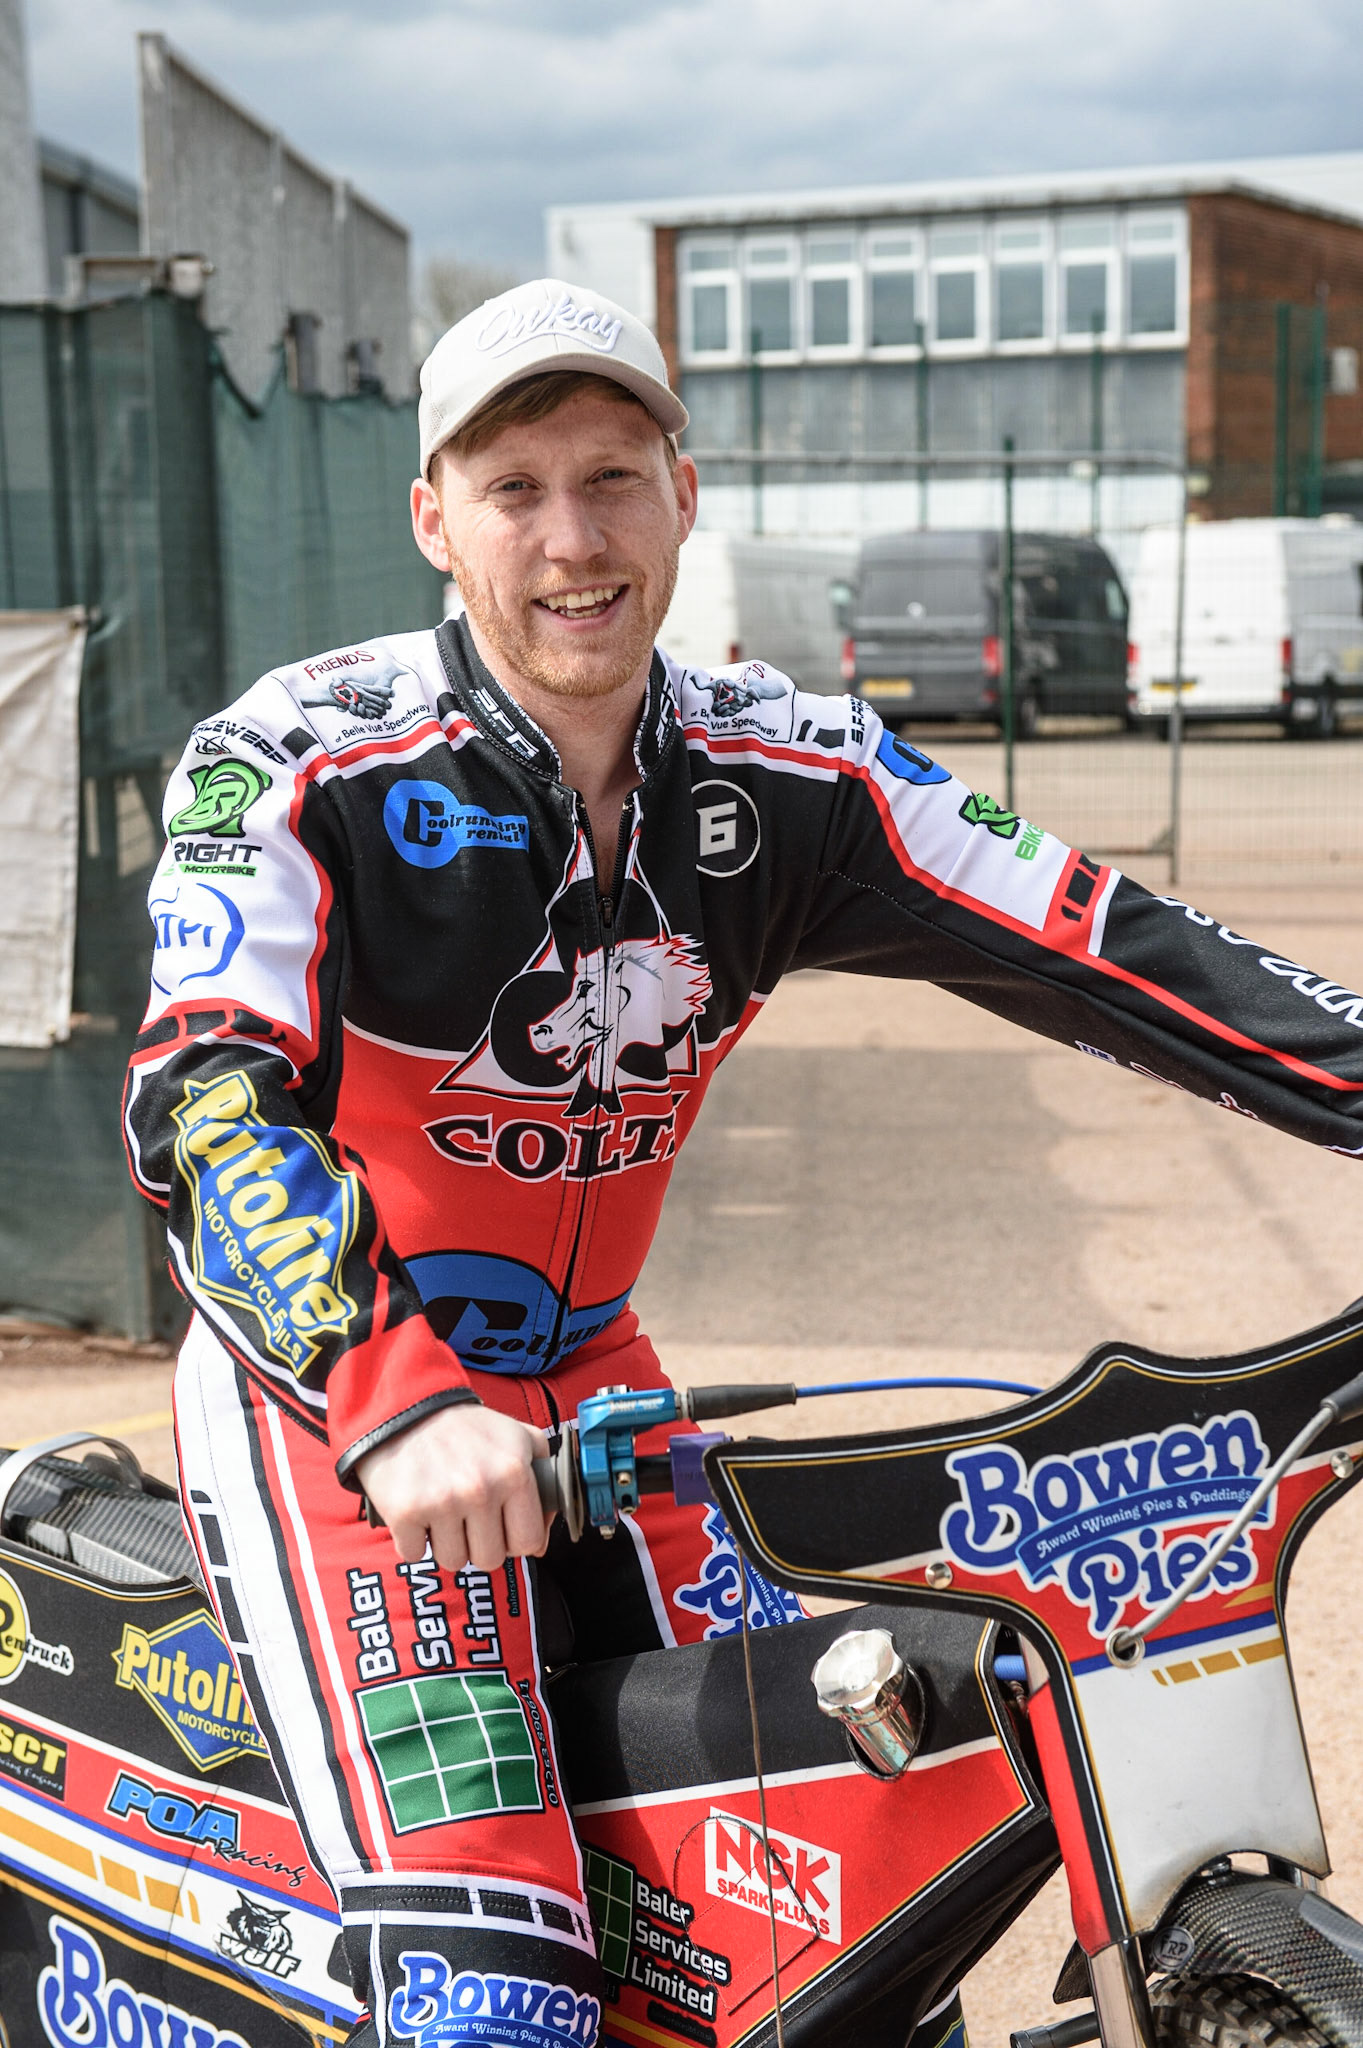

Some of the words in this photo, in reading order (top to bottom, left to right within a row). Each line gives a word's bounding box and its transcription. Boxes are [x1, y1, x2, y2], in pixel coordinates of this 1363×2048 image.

[303, 650, 376, 681] FRIENDS
[342, 723, 365, 739] Belle
[367, 722, 384, 734] Vue
[383, 703, 431, 732] Speedway
[711, 719, 729, 730] Vue
[731, 717, 778, 738] Speedway
[467, 827, 521, 843] rental
[184, 865, 256, 875] MOTORBIKE
[421, 1112, 676, 1183] COLT
[945, 1415, 1265, 1568] Bowen
[1036, 1524, 1081, 1559] Award
[1081, 1505, 1141, 1533] Winning
[1143, 1496, 1174, 1517] Pies
[1177, 1495, 1188, 1509] &
[1190, 1487, 1253, 1507] Puddings
[1067, 1526, 1253, 1633] Pies
[350, 1569, 397, 1681] Baler
[107, 1772, 240, 1851] POA
[213, 1837, 307, 1888] Racing
[715, 1817, 831, 1913] NGK
[636, 1880, 691, 1923] Baler
[717, 1877, 770, 1911] SPARK
[773, 1901, 830, 1935] PLUGS
[634, 1918, 728, 1981] Services
[391, 1955, 600, 2046] Bowen
[631, 1955, 714, 2016] Limited
[432, 2022, 469, 2035] Award
[471, 2022, 517, 2039] Winning
[519, 2029, 541, 2045] Pies
